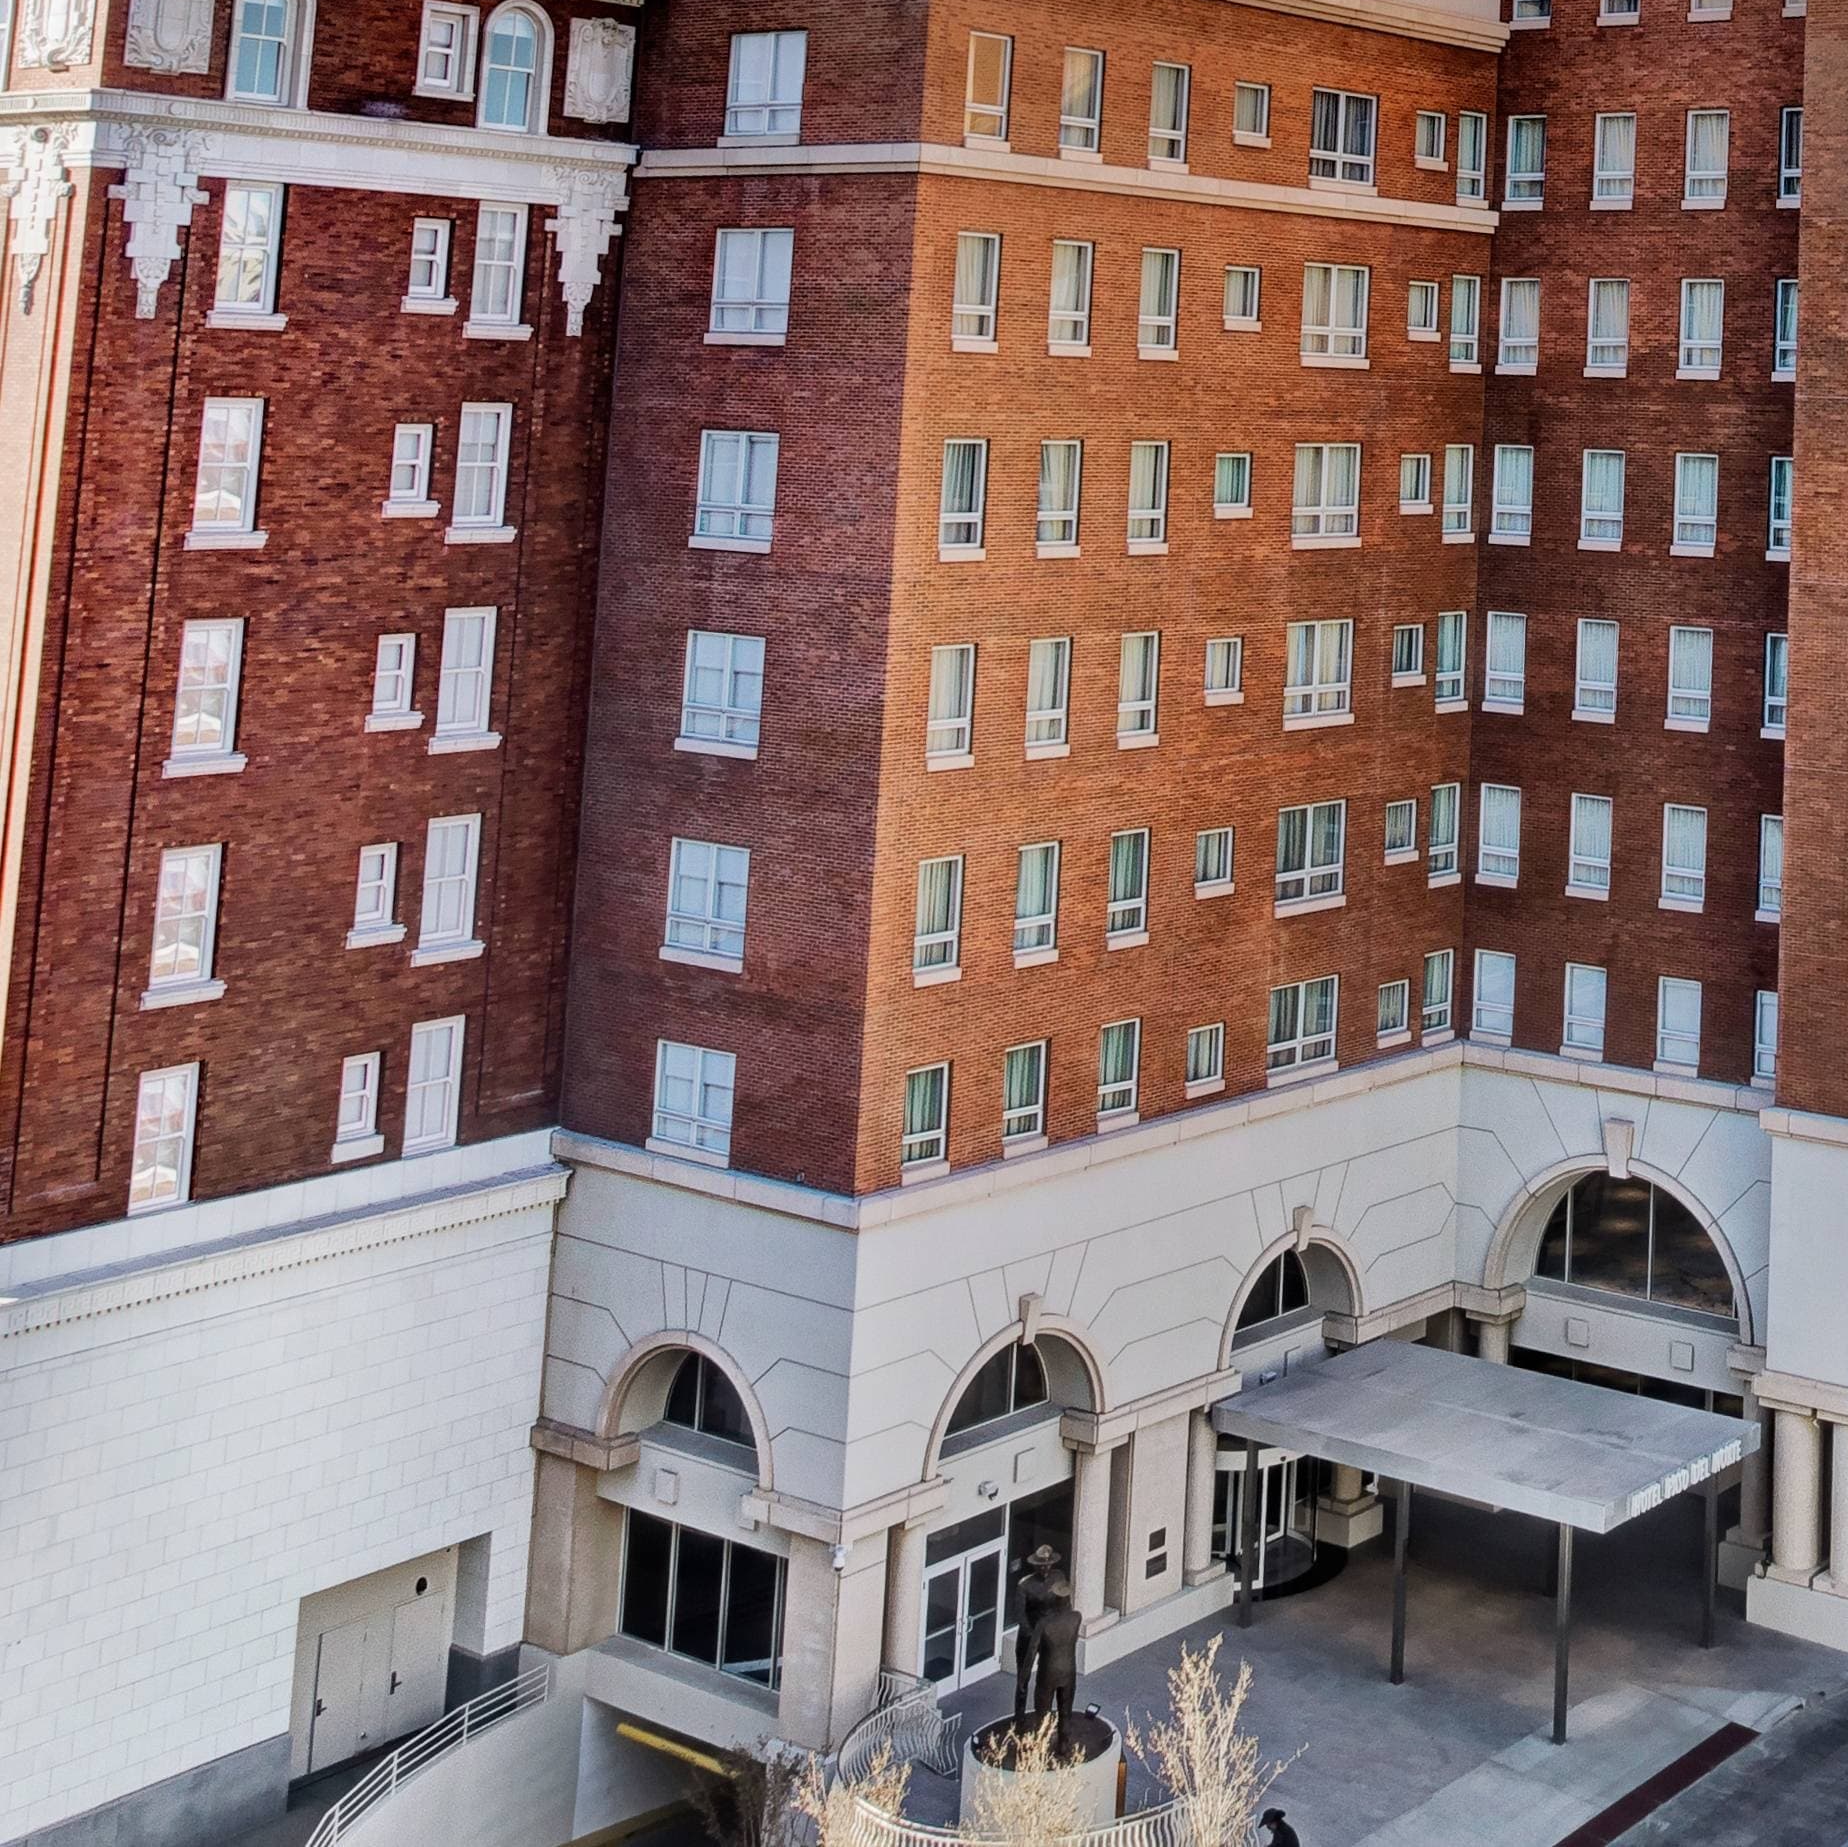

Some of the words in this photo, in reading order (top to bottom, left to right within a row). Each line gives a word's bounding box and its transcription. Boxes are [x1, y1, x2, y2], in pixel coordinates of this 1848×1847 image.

[1630, 1482, 1664, 1519] HOTEL
[1664, 1468, 1689, 1499] PASO
[1690, 1456, 1711, 1484] DEL
[1711, 1439, 1742, 1474] NORTE
